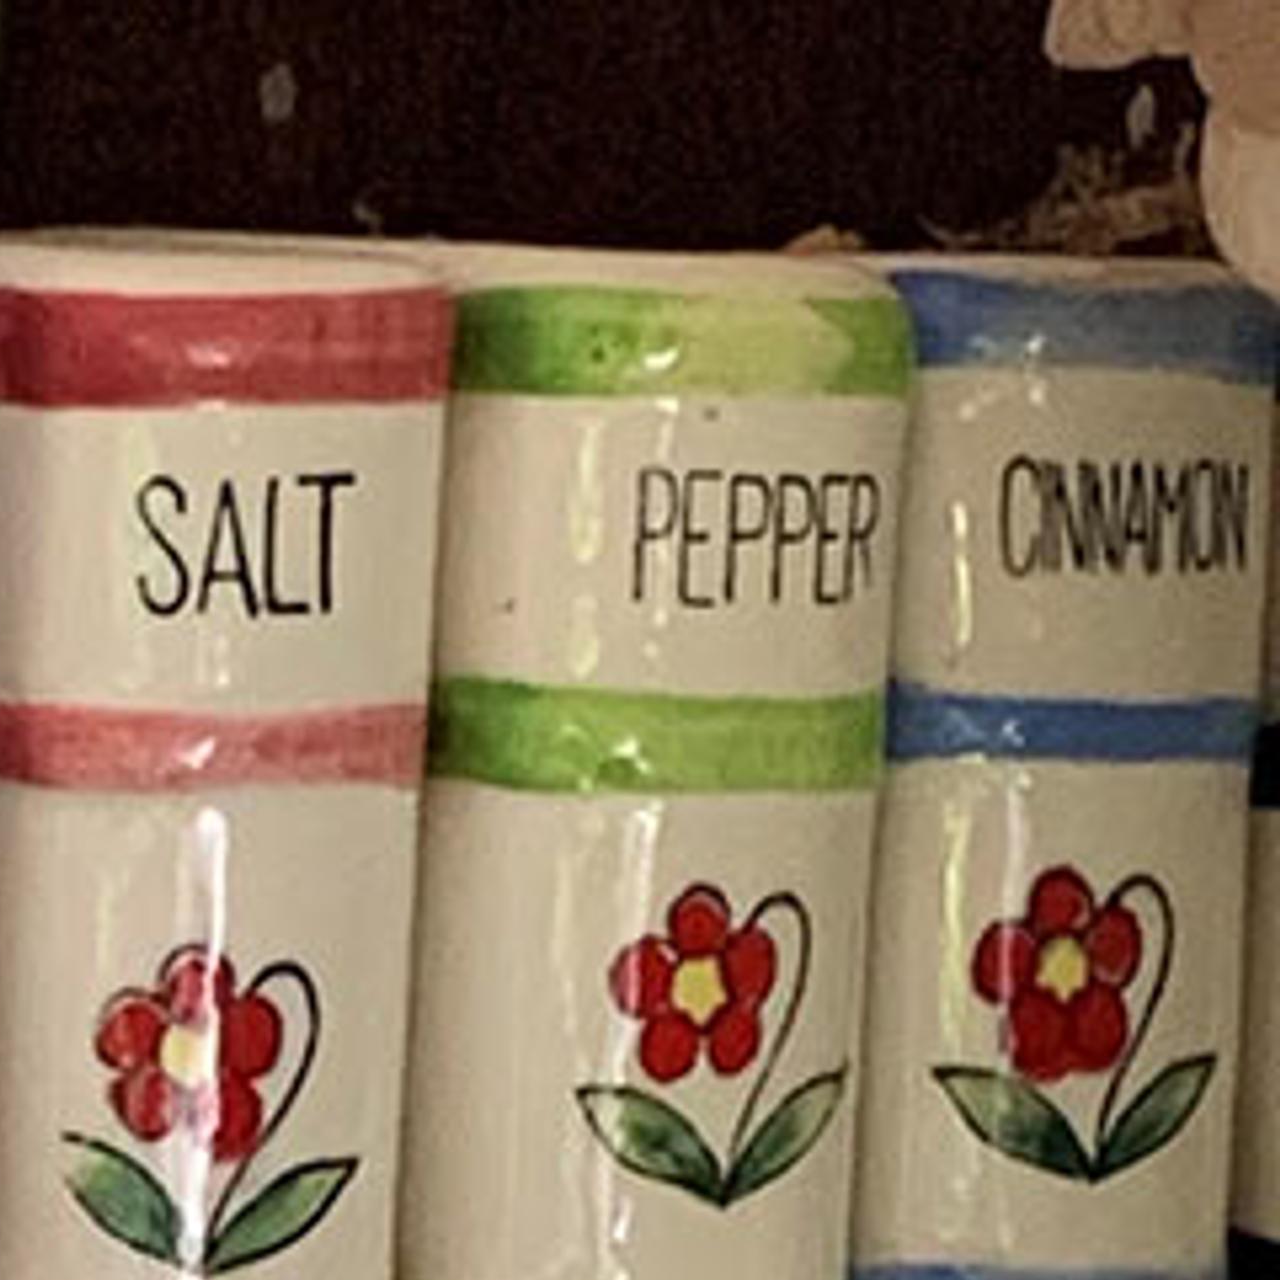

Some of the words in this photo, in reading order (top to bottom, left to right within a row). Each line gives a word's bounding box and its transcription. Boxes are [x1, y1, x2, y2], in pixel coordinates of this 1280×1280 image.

[136, 472, 356, 618] SALT
[631, 466, 880, 608] PEPPER
[999, 454, 1248, 578] CINNAMON
